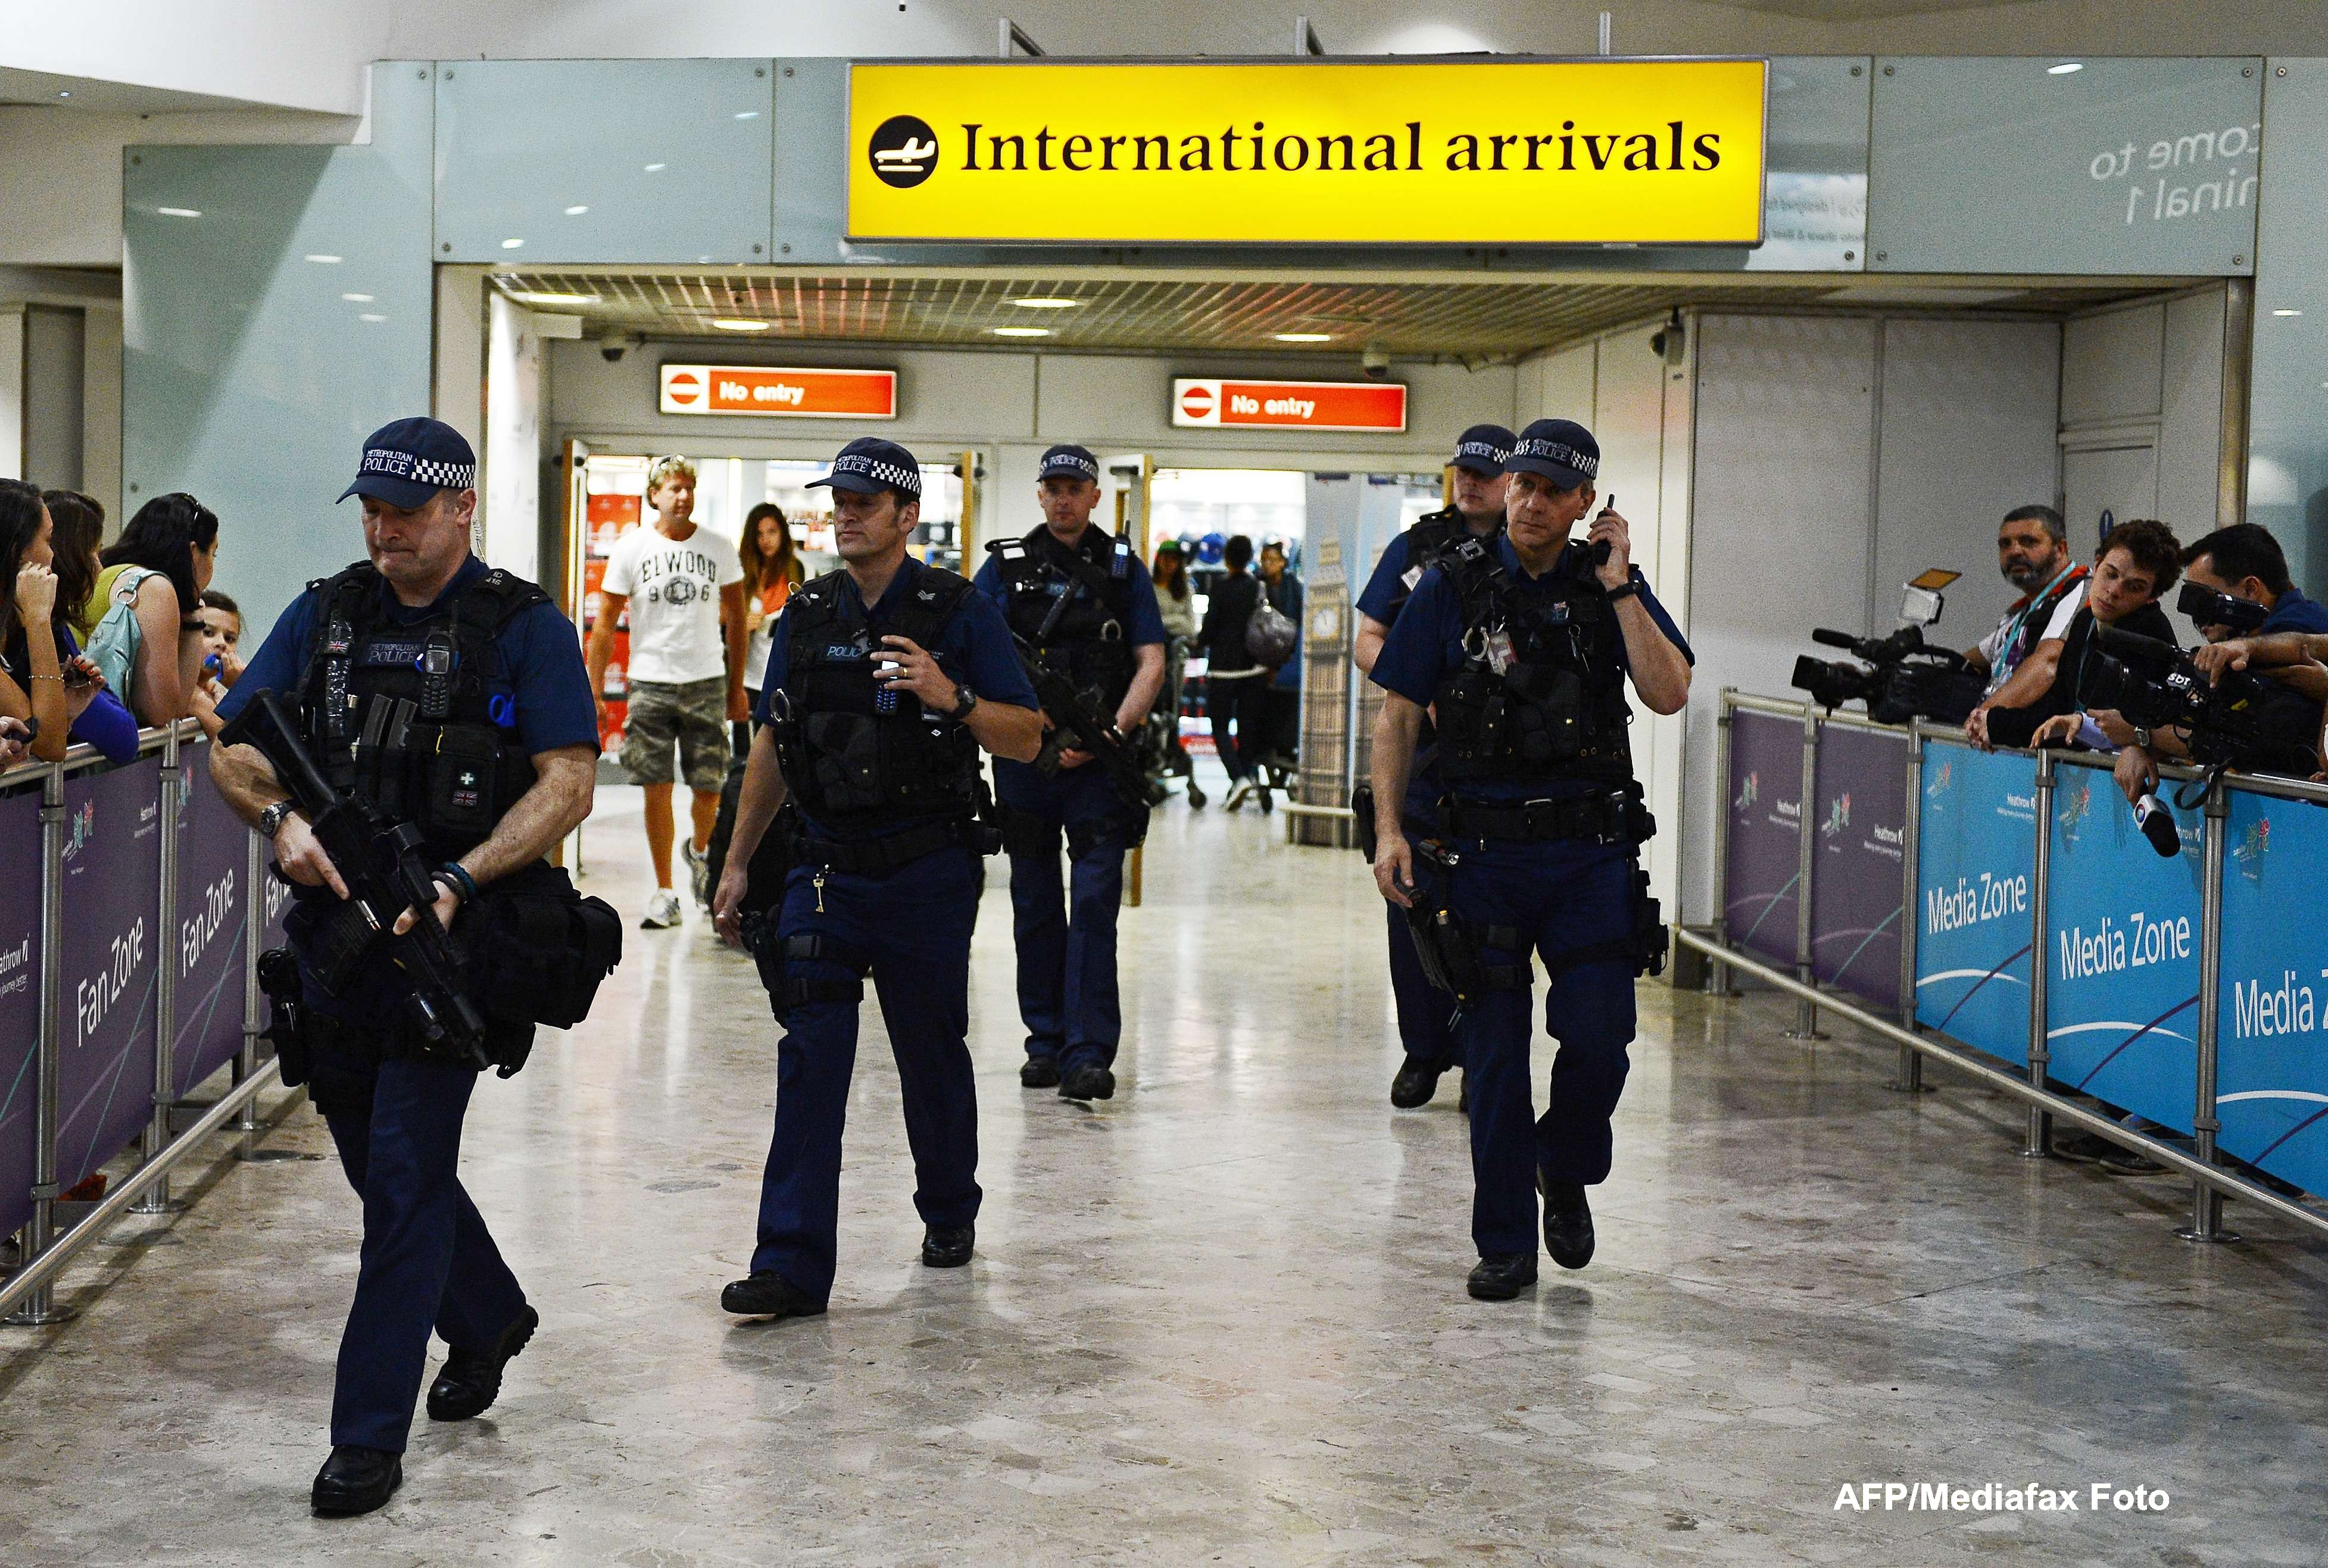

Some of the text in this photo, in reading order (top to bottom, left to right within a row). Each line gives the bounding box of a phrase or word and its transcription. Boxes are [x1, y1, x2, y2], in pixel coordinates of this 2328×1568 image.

[961, 121, 1721, 172] International arrivals
[719, 381, 804, 406] No entry
[1231, 394, 1316, 420] No entry
[363, 457, 408, 475] POLICE
[366, 449, 413, 462] METROPOLITAN
[834, 461, 867, 473] POLICE
[1530, 445, 1568, 461] POLICE
[642, 551, 716, 583] ELWOOD
[367, 651, 417, 662] POLICE
[1928, 872, 2027, 935] Media Zone
[182, 867, 234, 979] Fan Zone
[2061, 911, 2191, 981] Media Zone
[78, 916, 143, 1048] Fan Zone
[2235, 970, 2314, 1039] Media
